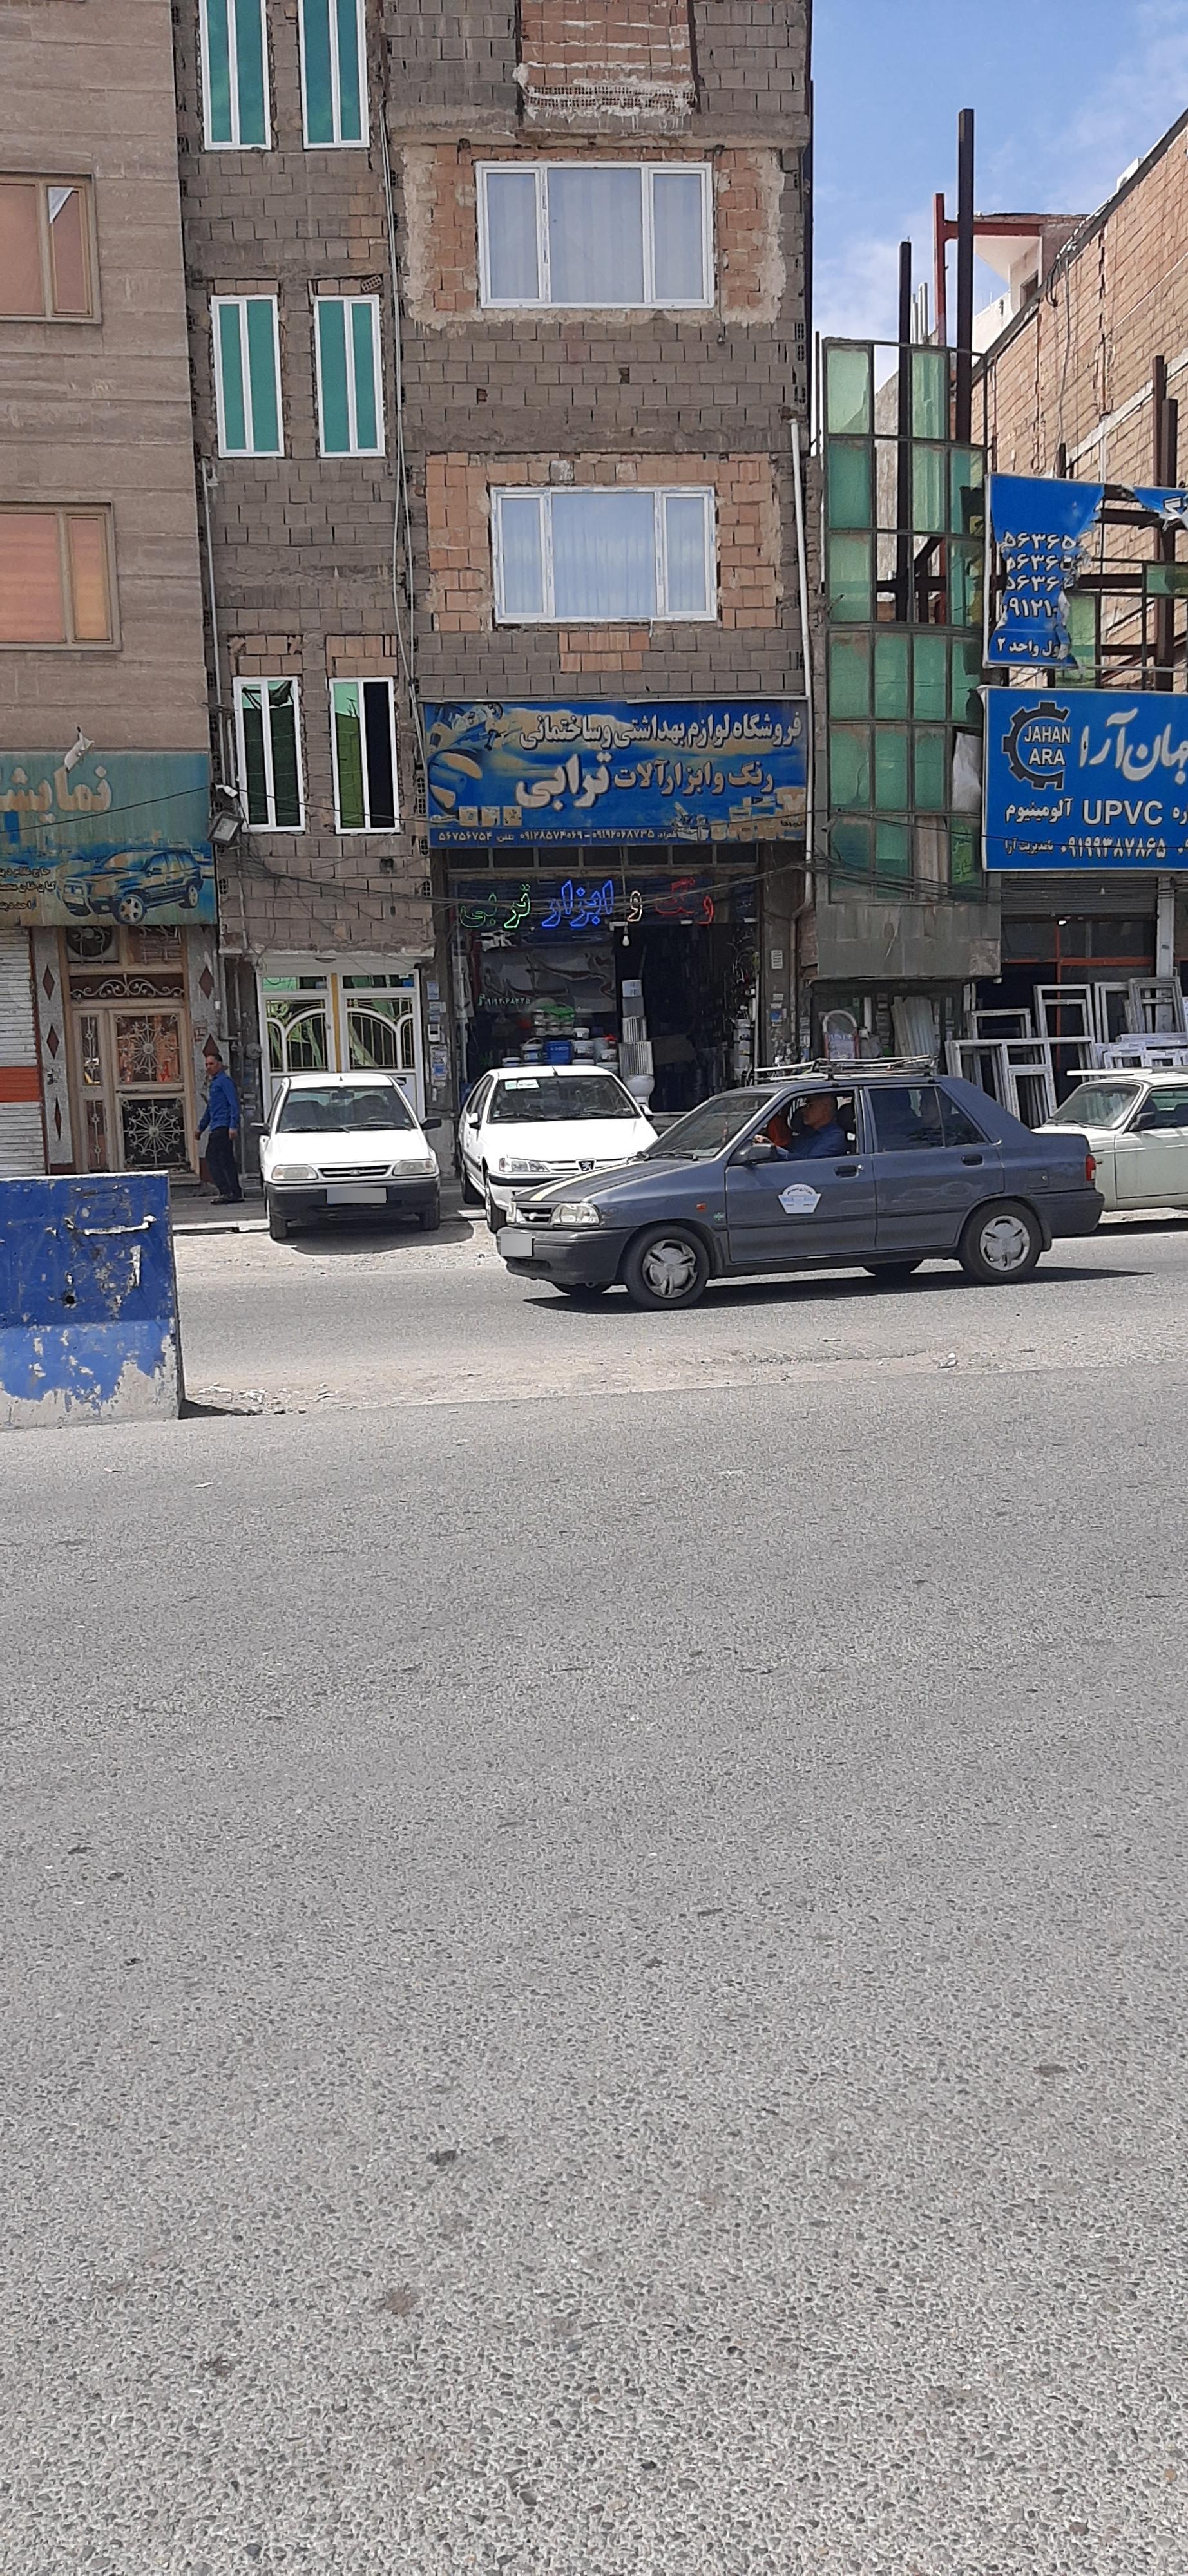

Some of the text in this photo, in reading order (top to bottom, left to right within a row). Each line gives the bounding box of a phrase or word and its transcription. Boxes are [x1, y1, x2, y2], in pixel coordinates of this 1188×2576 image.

[997, 636, 1006, 652] ۲
[1008, 638, 1039, 658] واحد
[614, 714, 685, 748] بهداشتی
[687, 713, 731, 748] لوازم
[733, 711, 802, 746] فروشگاه
[1024, 726, 1071, 744] JAHAN
[1078, 707, 1139, 768] آرا
[1028, 748, 1066, 766] ARA
[515, 751, 611, 811] ترابی
[727, 761, 774, 794] رنگ
[1005, 797, 1074, 824] آلومینیوم
[1082, 799, 1164, 826] UPVC
[541, 878, 614, 927] ابزار
[626, 889, 643, 922] و
